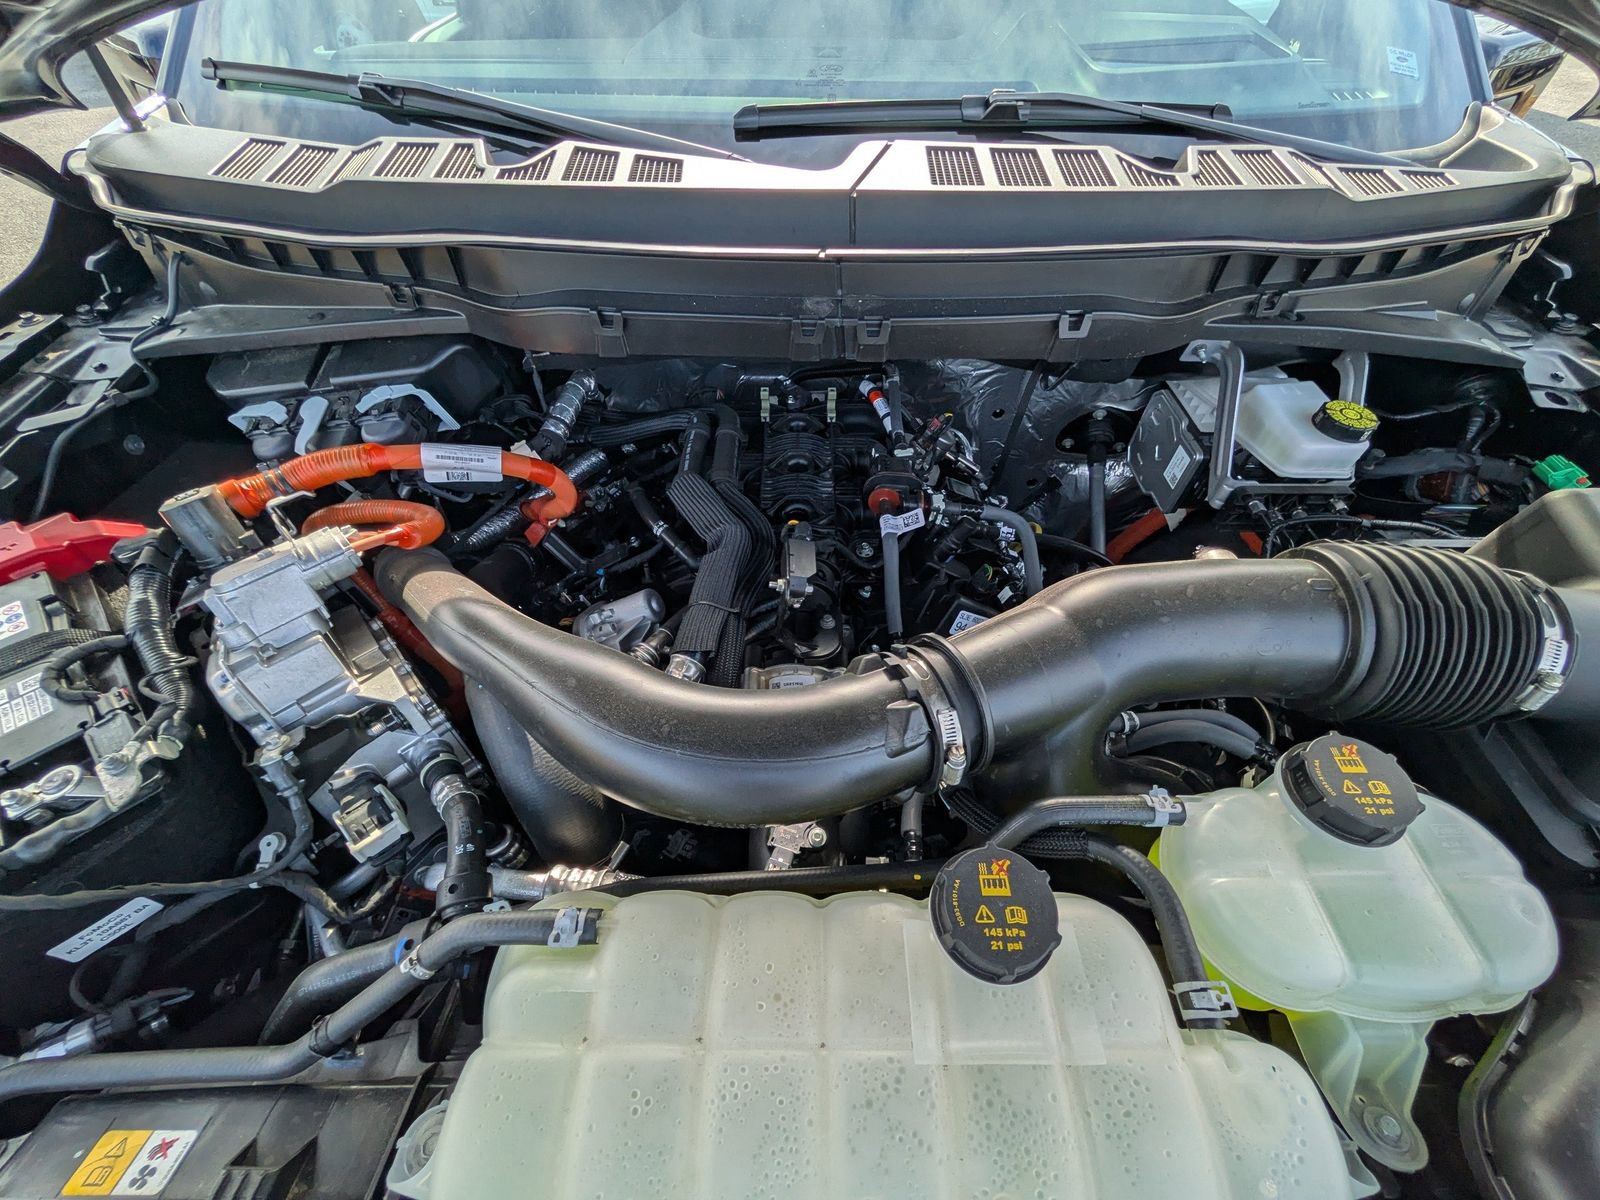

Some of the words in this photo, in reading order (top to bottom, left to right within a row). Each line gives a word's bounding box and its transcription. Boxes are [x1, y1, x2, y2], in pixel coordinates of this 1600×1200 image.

[1355, 797, 1373, 805] 145
[1375, 797, 1394, 805] kPa
[1364, 807, 1377, 815] 21
[1379, 807, 1395, 816] psi
[78, 913, 124, 940] FoMoCo
[983, 928, 1003, 937] 145
[1006, 928, 1026, 937] kPa
[990, 941, 1003, 950] 21
[1007, 941, 1023, 951] psi
